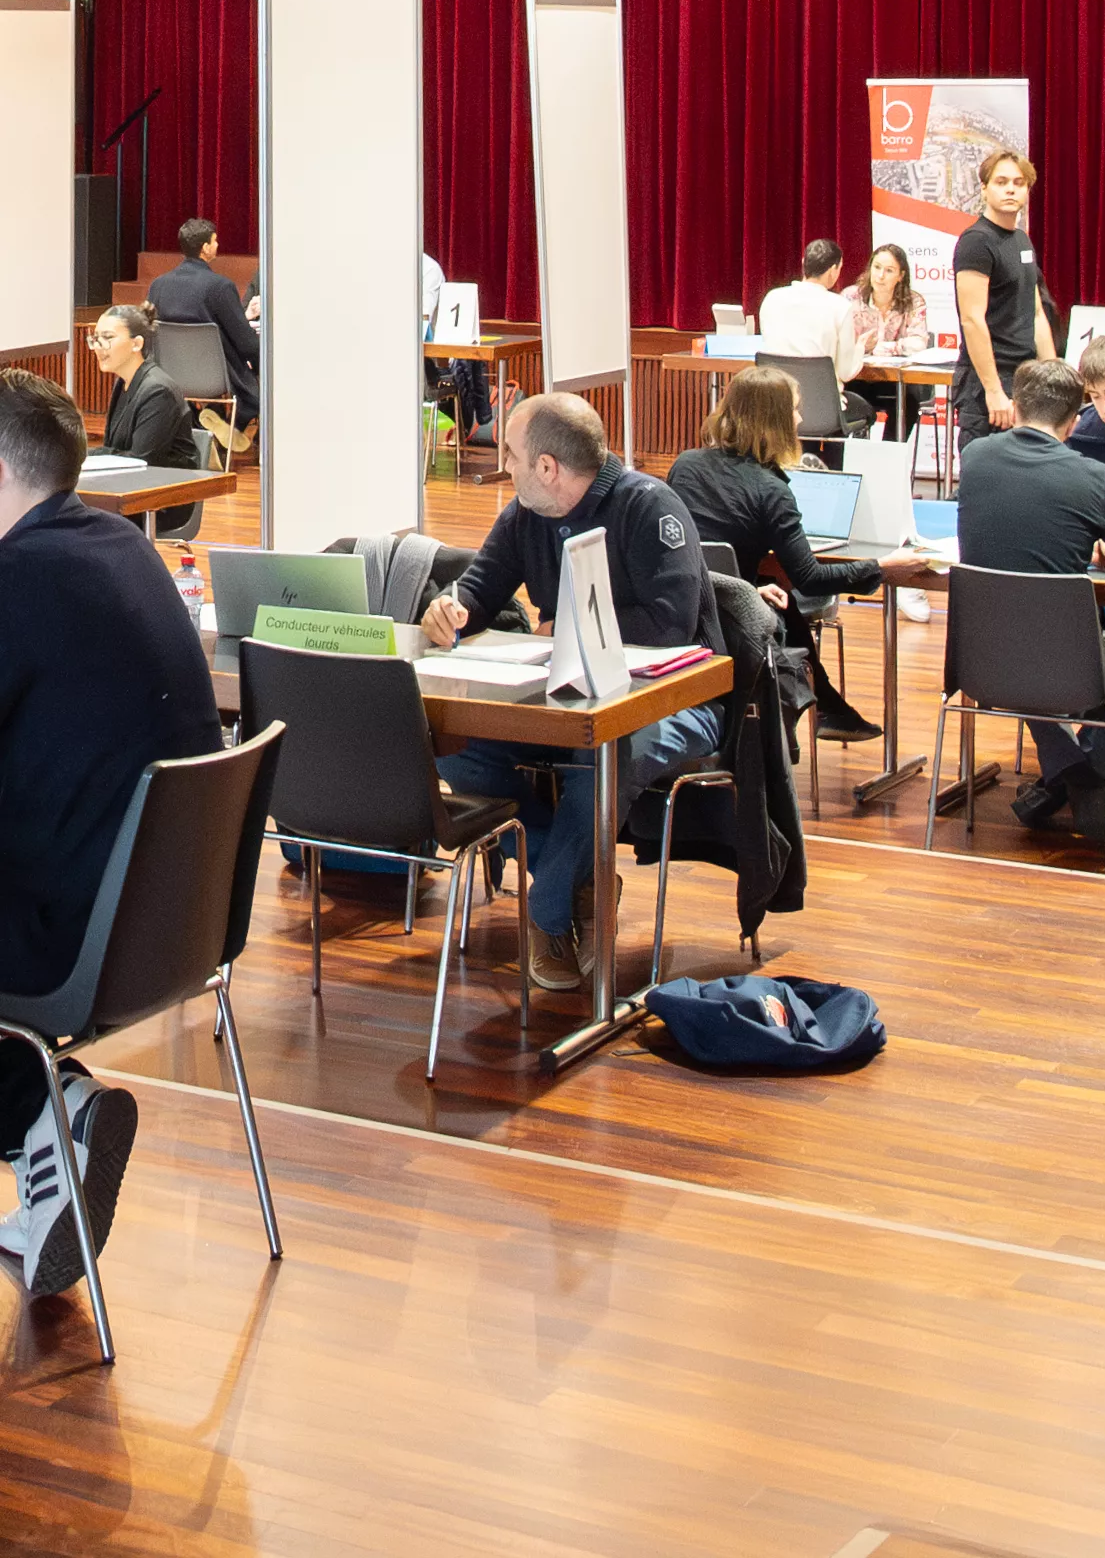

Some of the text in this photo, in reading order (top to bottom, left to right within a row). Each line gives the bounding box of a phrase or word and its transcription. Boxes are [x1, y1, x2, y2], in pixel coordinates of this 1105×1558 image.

[882, 87, 913, 132] b
[881, 133, 913, 145] barro
[908, 246, 938, 257] sens
[450, 303, 460, 327] 1
[281, 586, 298, 605] hp
[588, 583, 607, 650] 1
[265, 616, 387, 640] Conducteur véhicules
[304, 637, 340, 651] lourds
